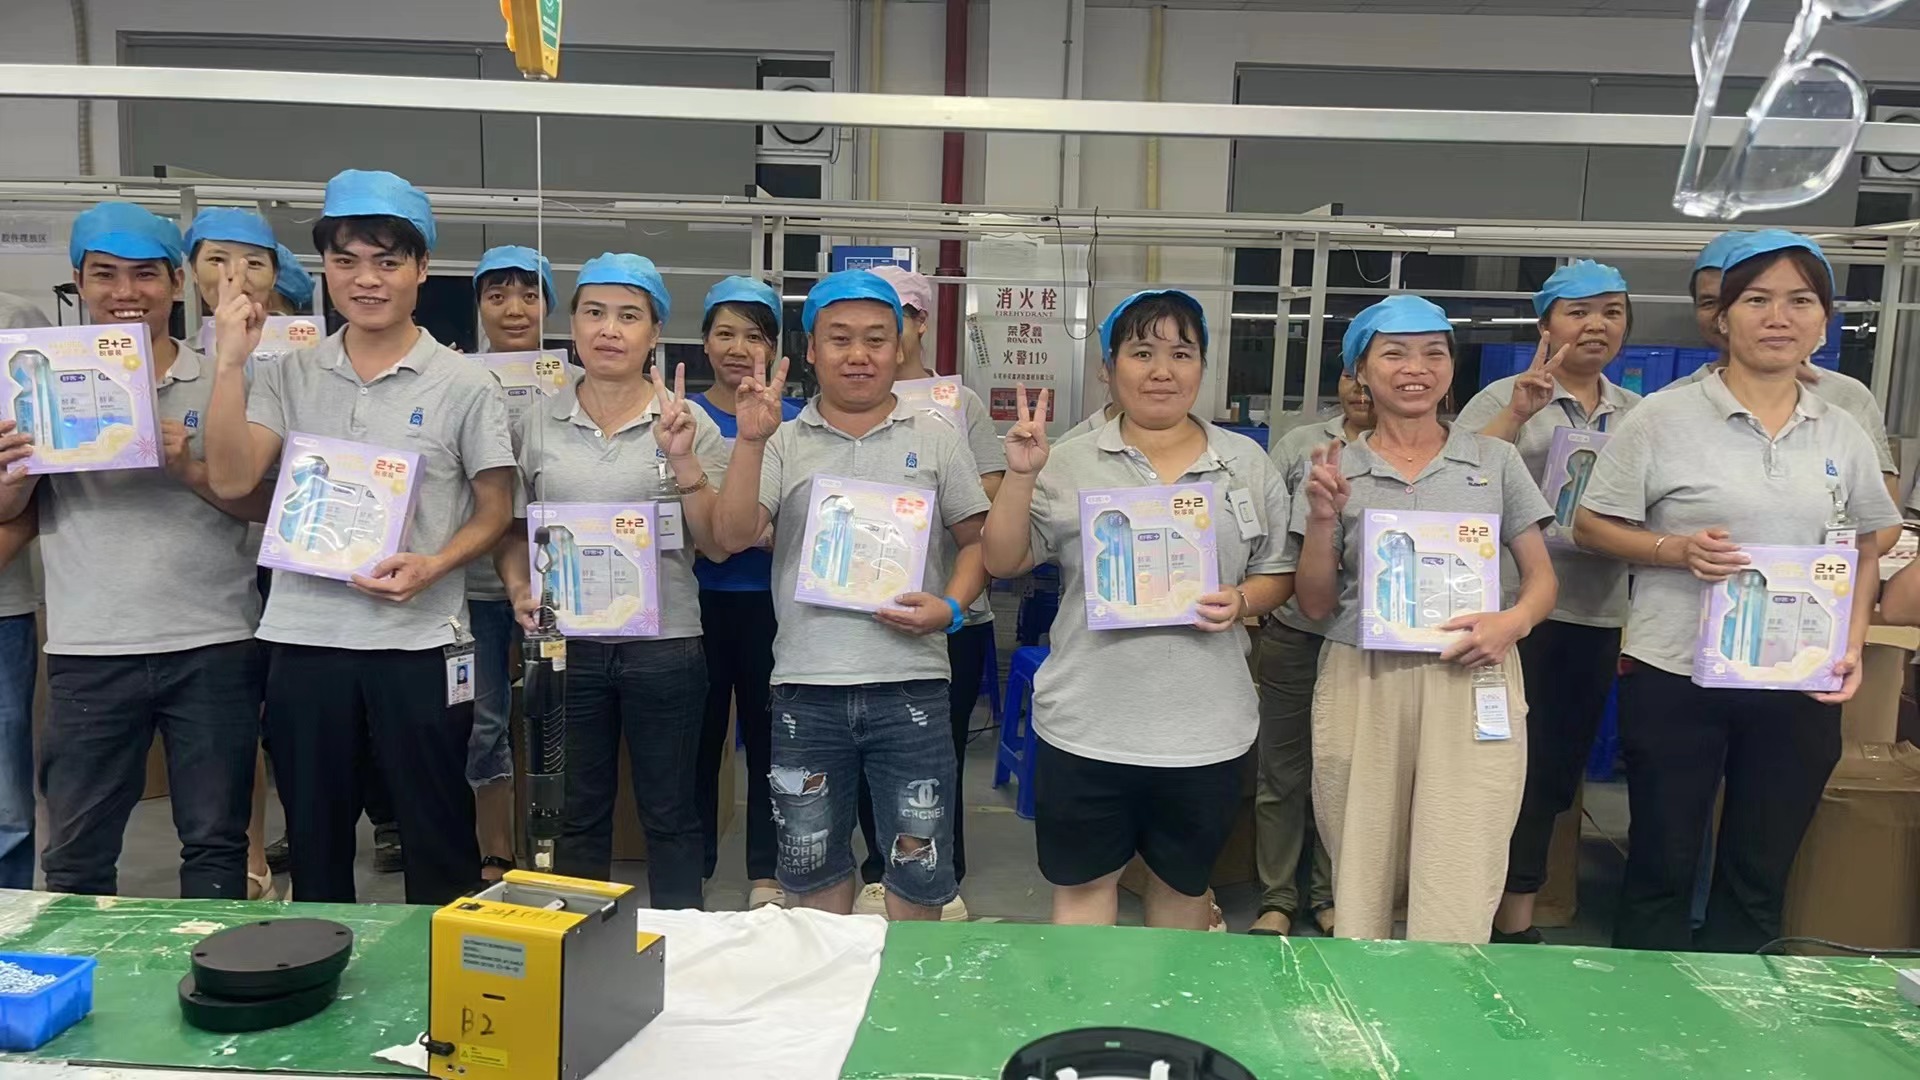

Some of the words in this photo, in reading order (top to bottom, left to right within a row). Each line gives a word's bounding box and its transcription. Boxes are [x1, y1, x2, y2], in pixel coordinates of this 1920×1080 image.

[996, 287, 1057, 310] 消火栓
[289, 326, 316, 336] 2+2
[98, 338, 132, 349] 2+2
[535, 361, 560, 370] 2+2
[376, 459, 406, 473] 2+2
[1173, 497, 1203, 509] 2+2
[616, 518, 644, 528] 2+2
[1459, 525, 1489, 536] 2+2
[1815, 563, 1846, 574] 2+2
[785, 834, 810, 845] THE
